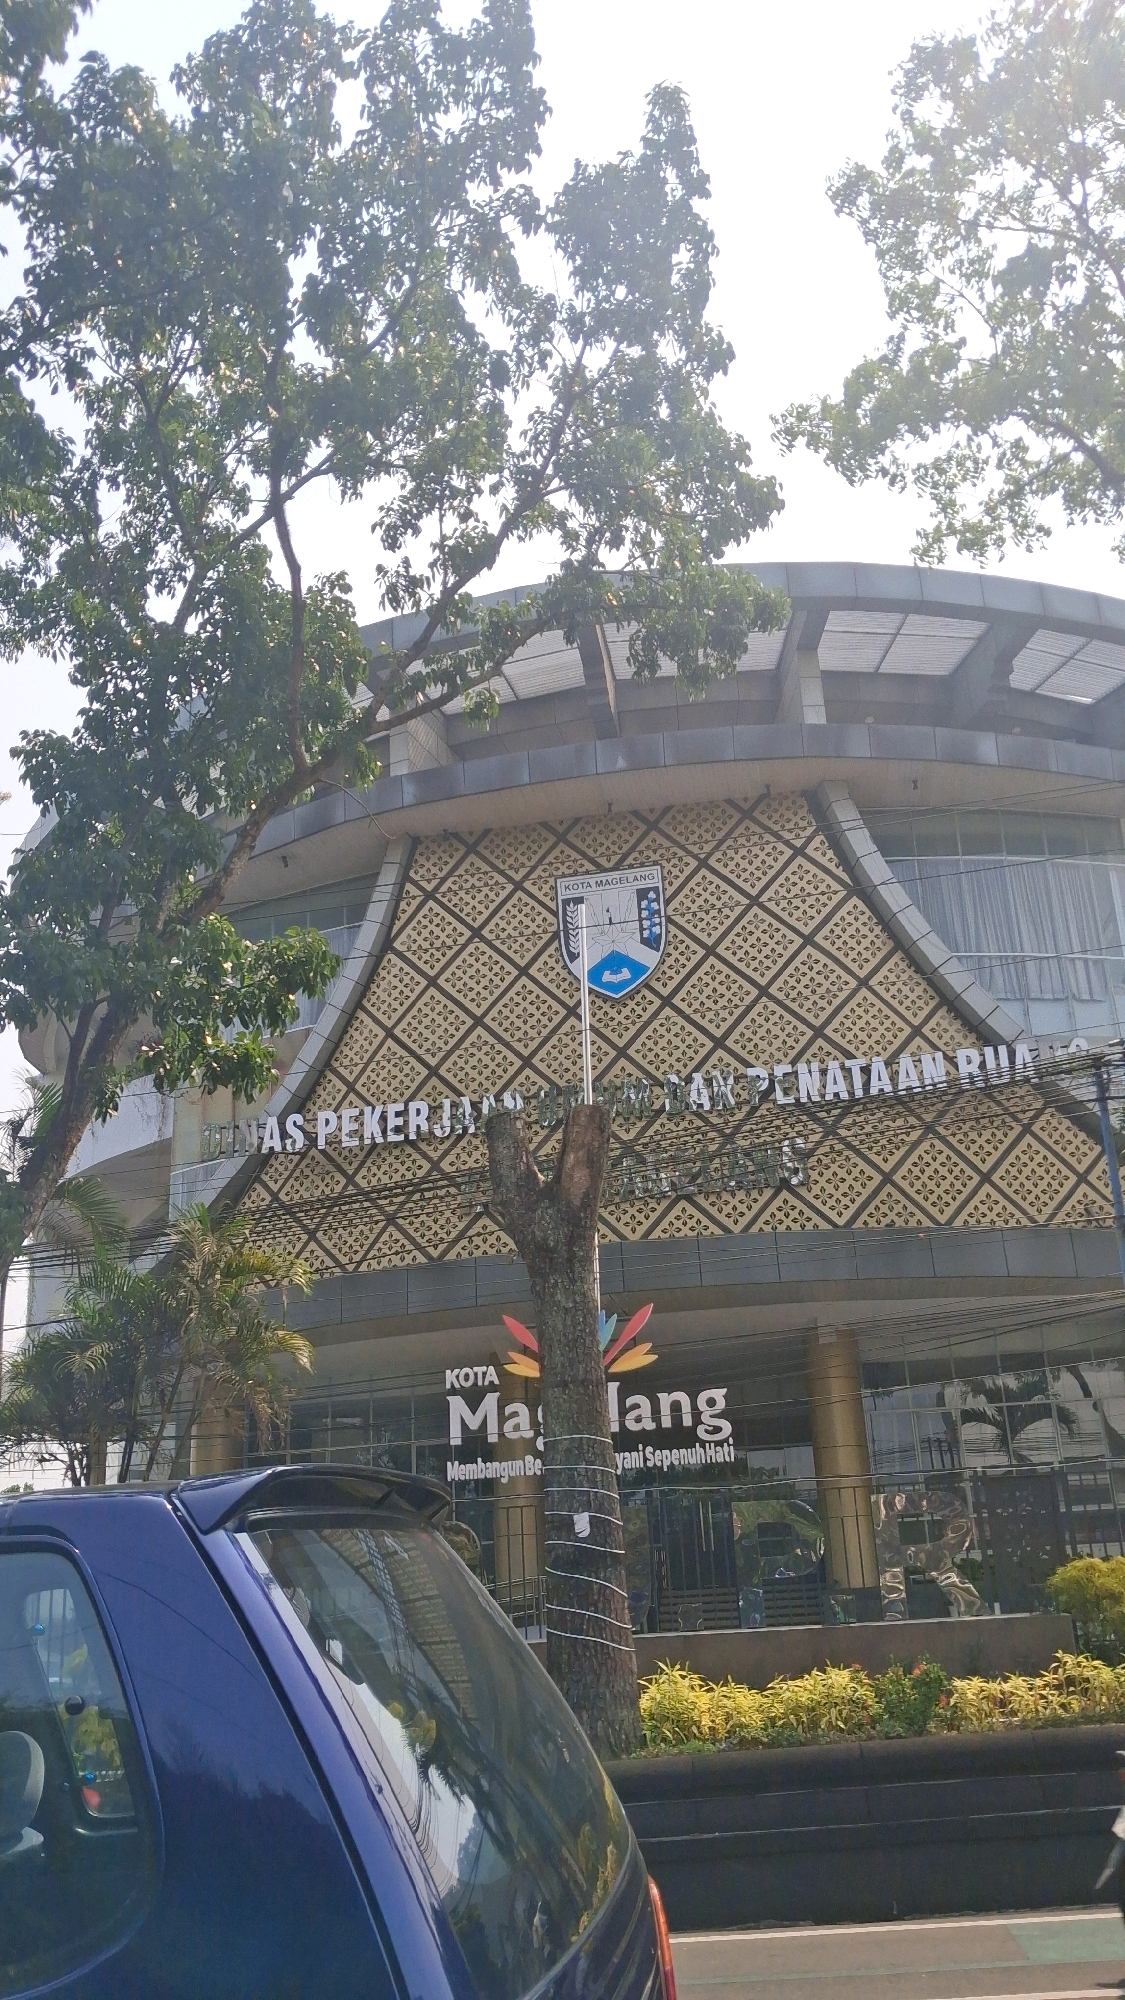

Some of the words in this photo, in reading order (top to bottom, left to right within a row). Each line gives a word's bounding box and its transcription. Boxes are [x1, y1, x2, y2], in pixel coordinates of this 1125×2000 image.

[564, 881, 592, 893] KOTA
[596, 873, 655, 888] MAGELANG
[201, 1113, 305, 1161] DINAS
[664, 1070, 736, 1115] DAN
[746, 1050, 948, 1107] PENATAAN
[445, 1365, 500, 1389] KOTA
[446, 1381, 733, 1451] Malang
[447, 1457, 524, 1484] Membangun
[614, 1443, 643, 1475] yani
[646, 1440, 705, 1472] Sepenuh
[705, 1436, 735, 1464] Hati
